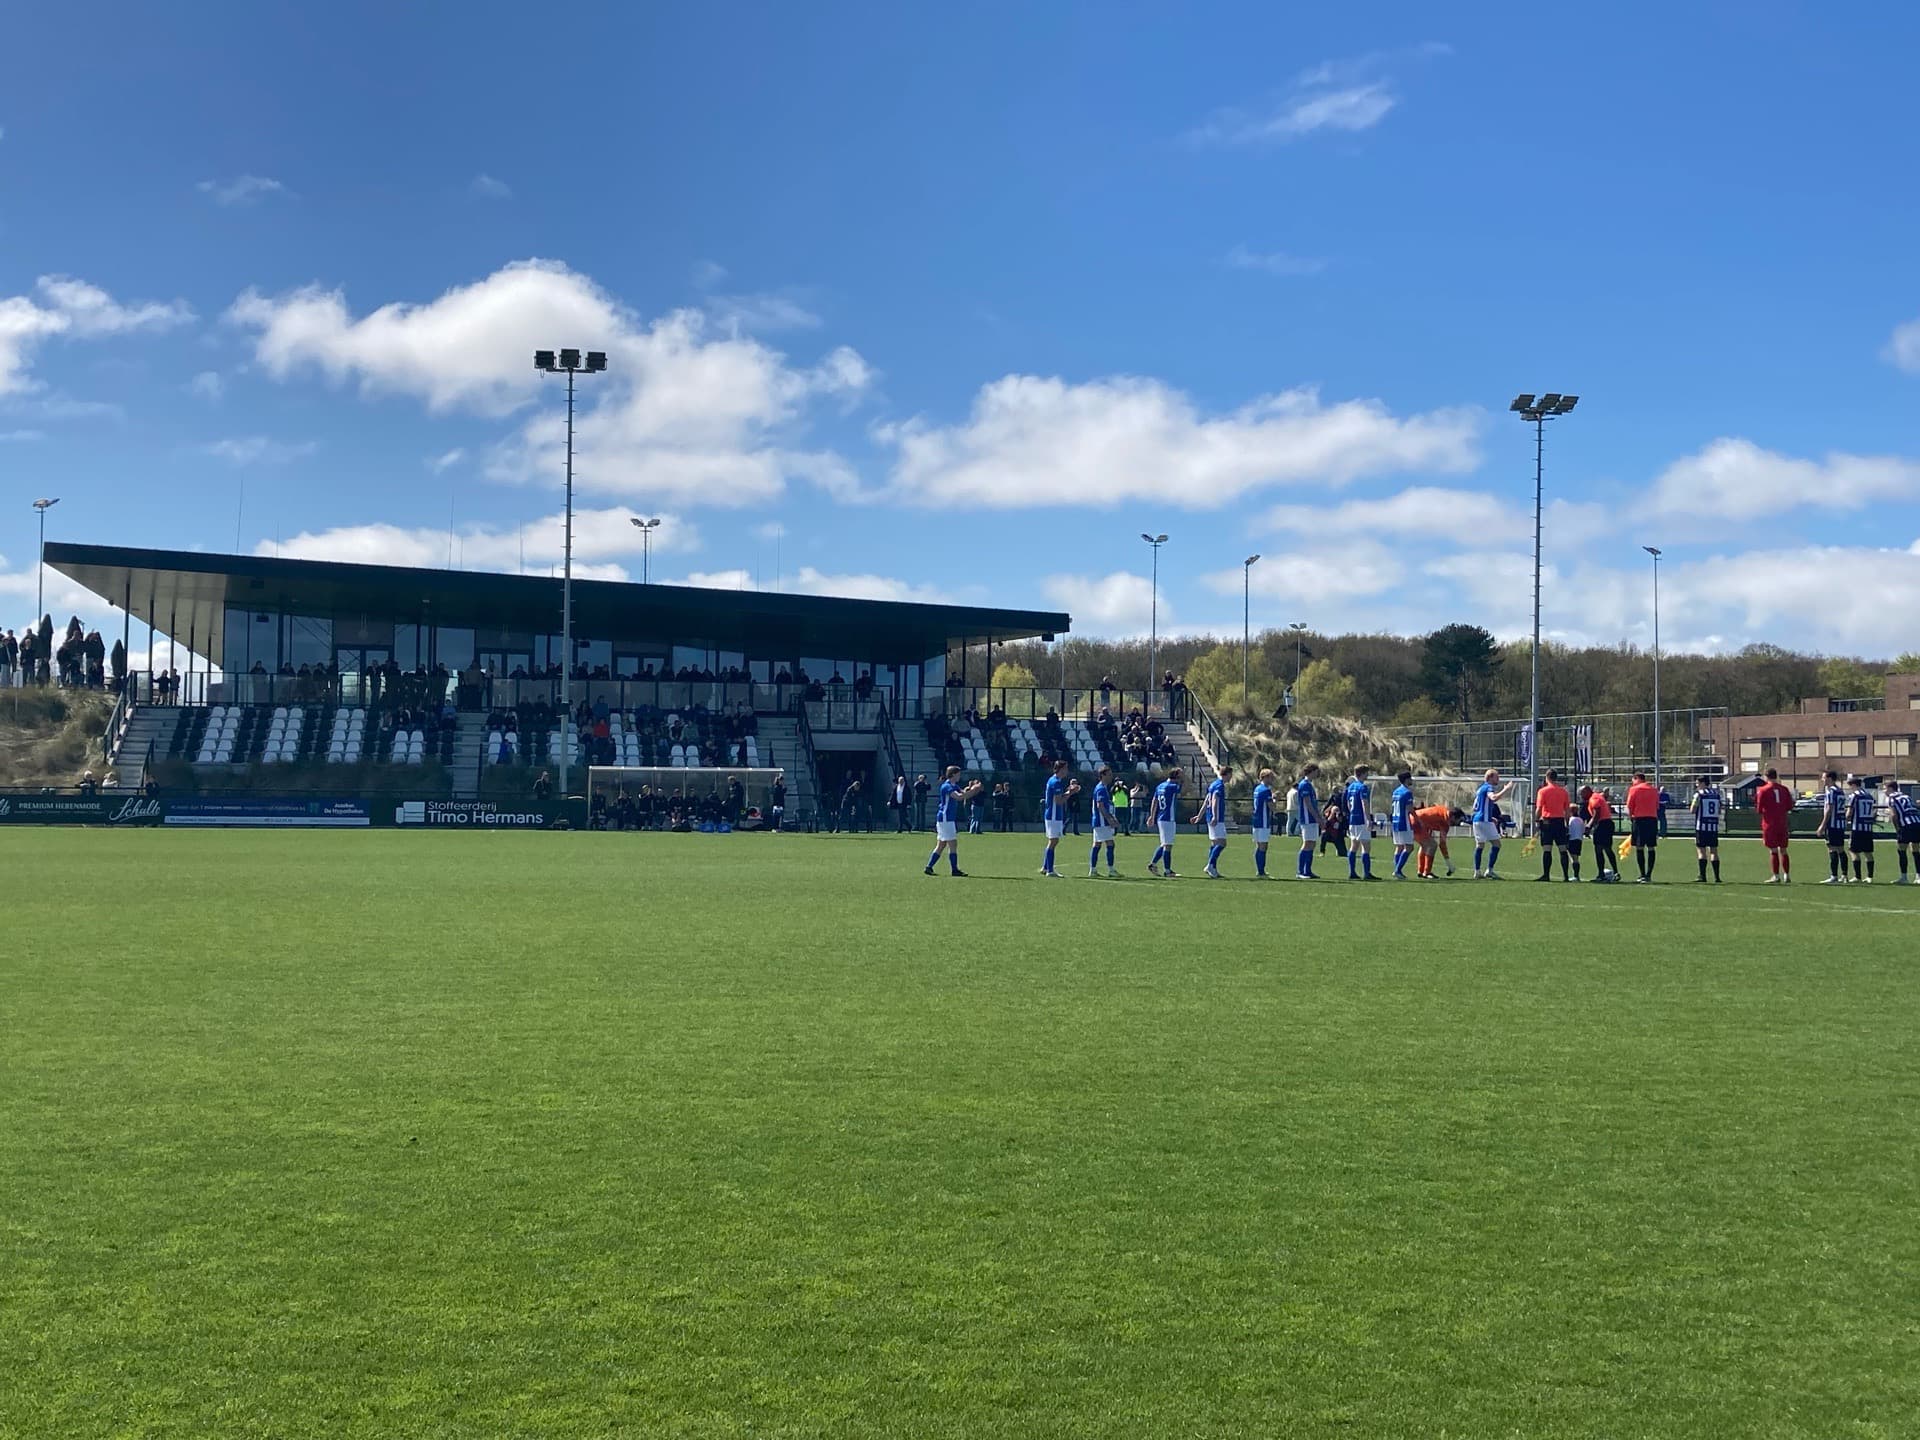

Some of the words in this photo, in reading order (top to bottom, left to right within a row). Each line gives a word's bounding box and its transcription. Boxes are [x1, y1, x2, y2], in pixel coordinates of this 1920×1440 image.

[1157, 795, 1167, 810] 13
[1773, 788, 1780, 803] 1
[428, 801, 497, 812] Stoffeerderij
[1708, 800, 1715, 815] 8
[1862, 801, 1872, 815] 17
[428, 811, 468, 823] Timo
[473, 811, 544, 824] Hermans
